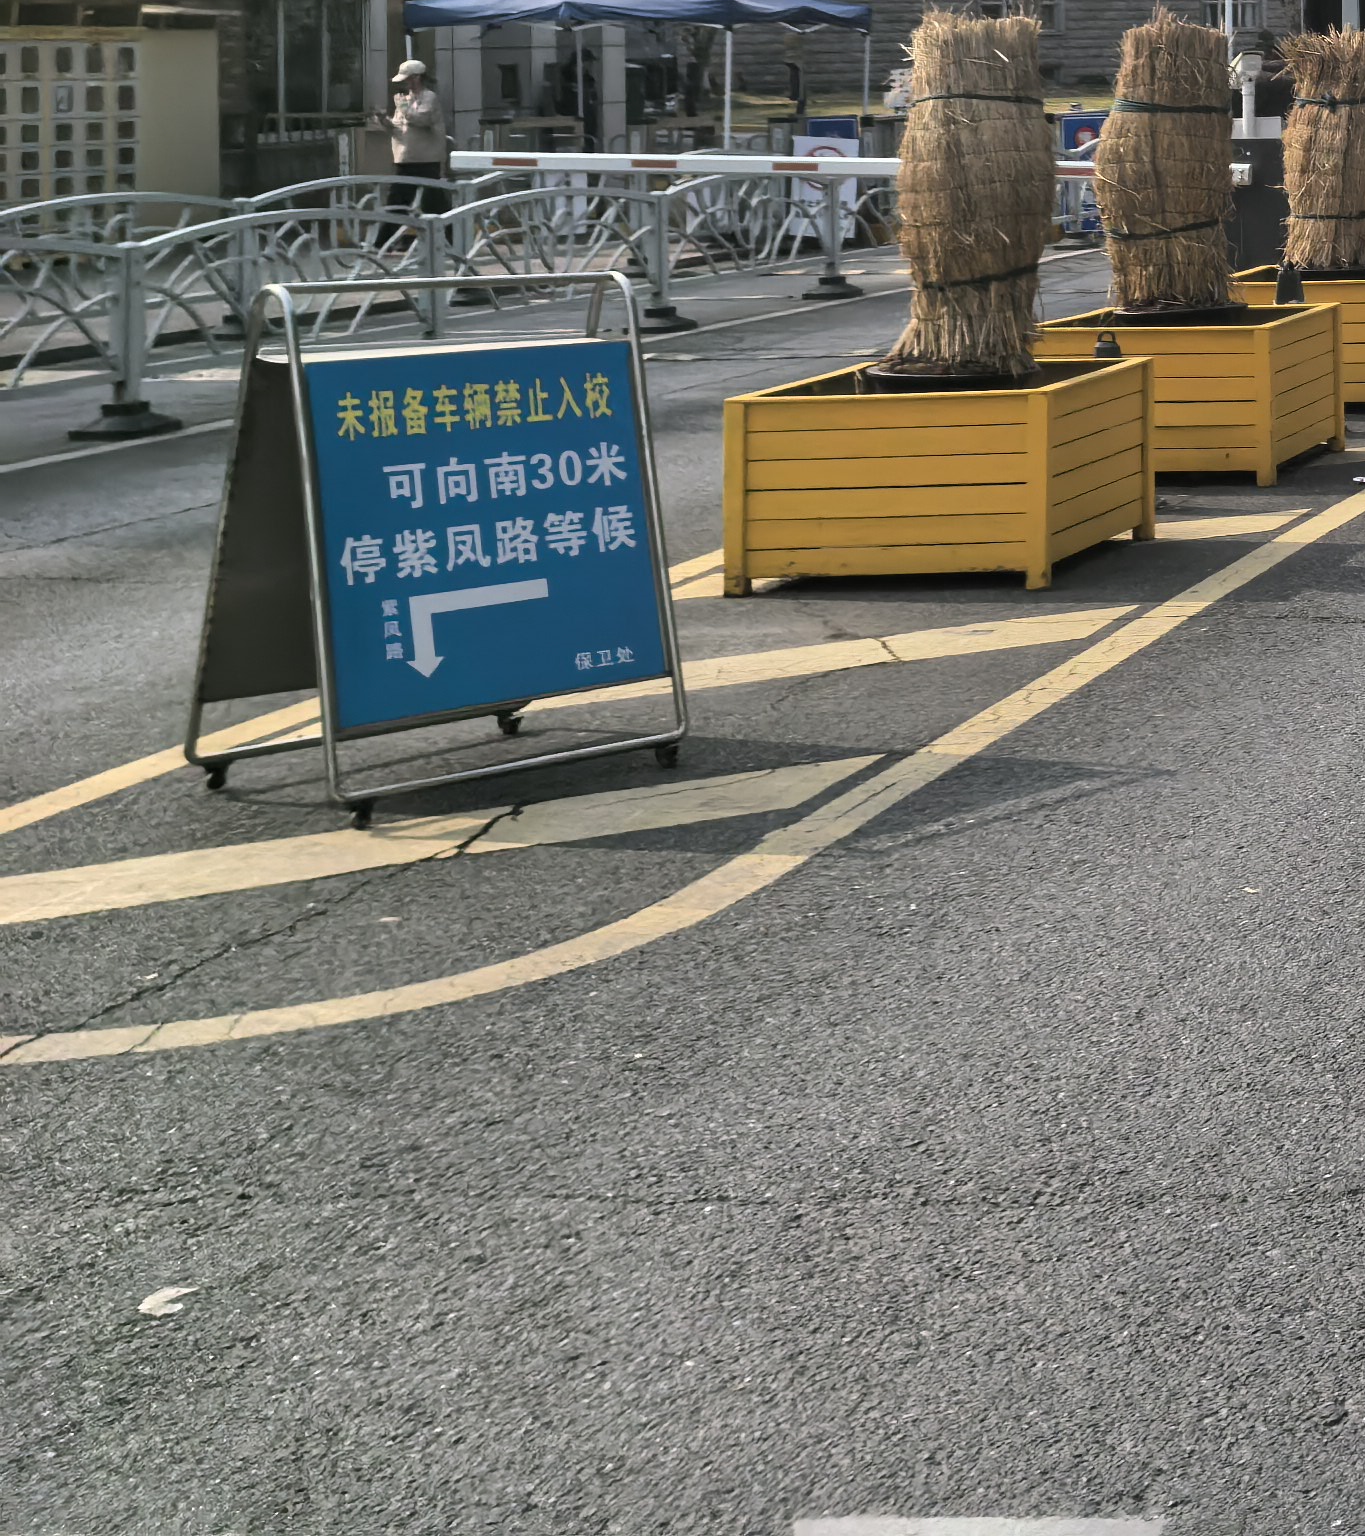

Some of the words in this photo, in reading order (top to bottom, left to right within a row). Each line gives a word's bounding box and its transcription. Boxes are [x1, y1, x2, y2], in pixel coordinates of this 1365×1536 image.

[336, 372, 613, 441] 未报备车辆禁止入校
[382, 442, 628, 510] 可向南30米
[339, 505, 637, 586] 停紫凤路等候
